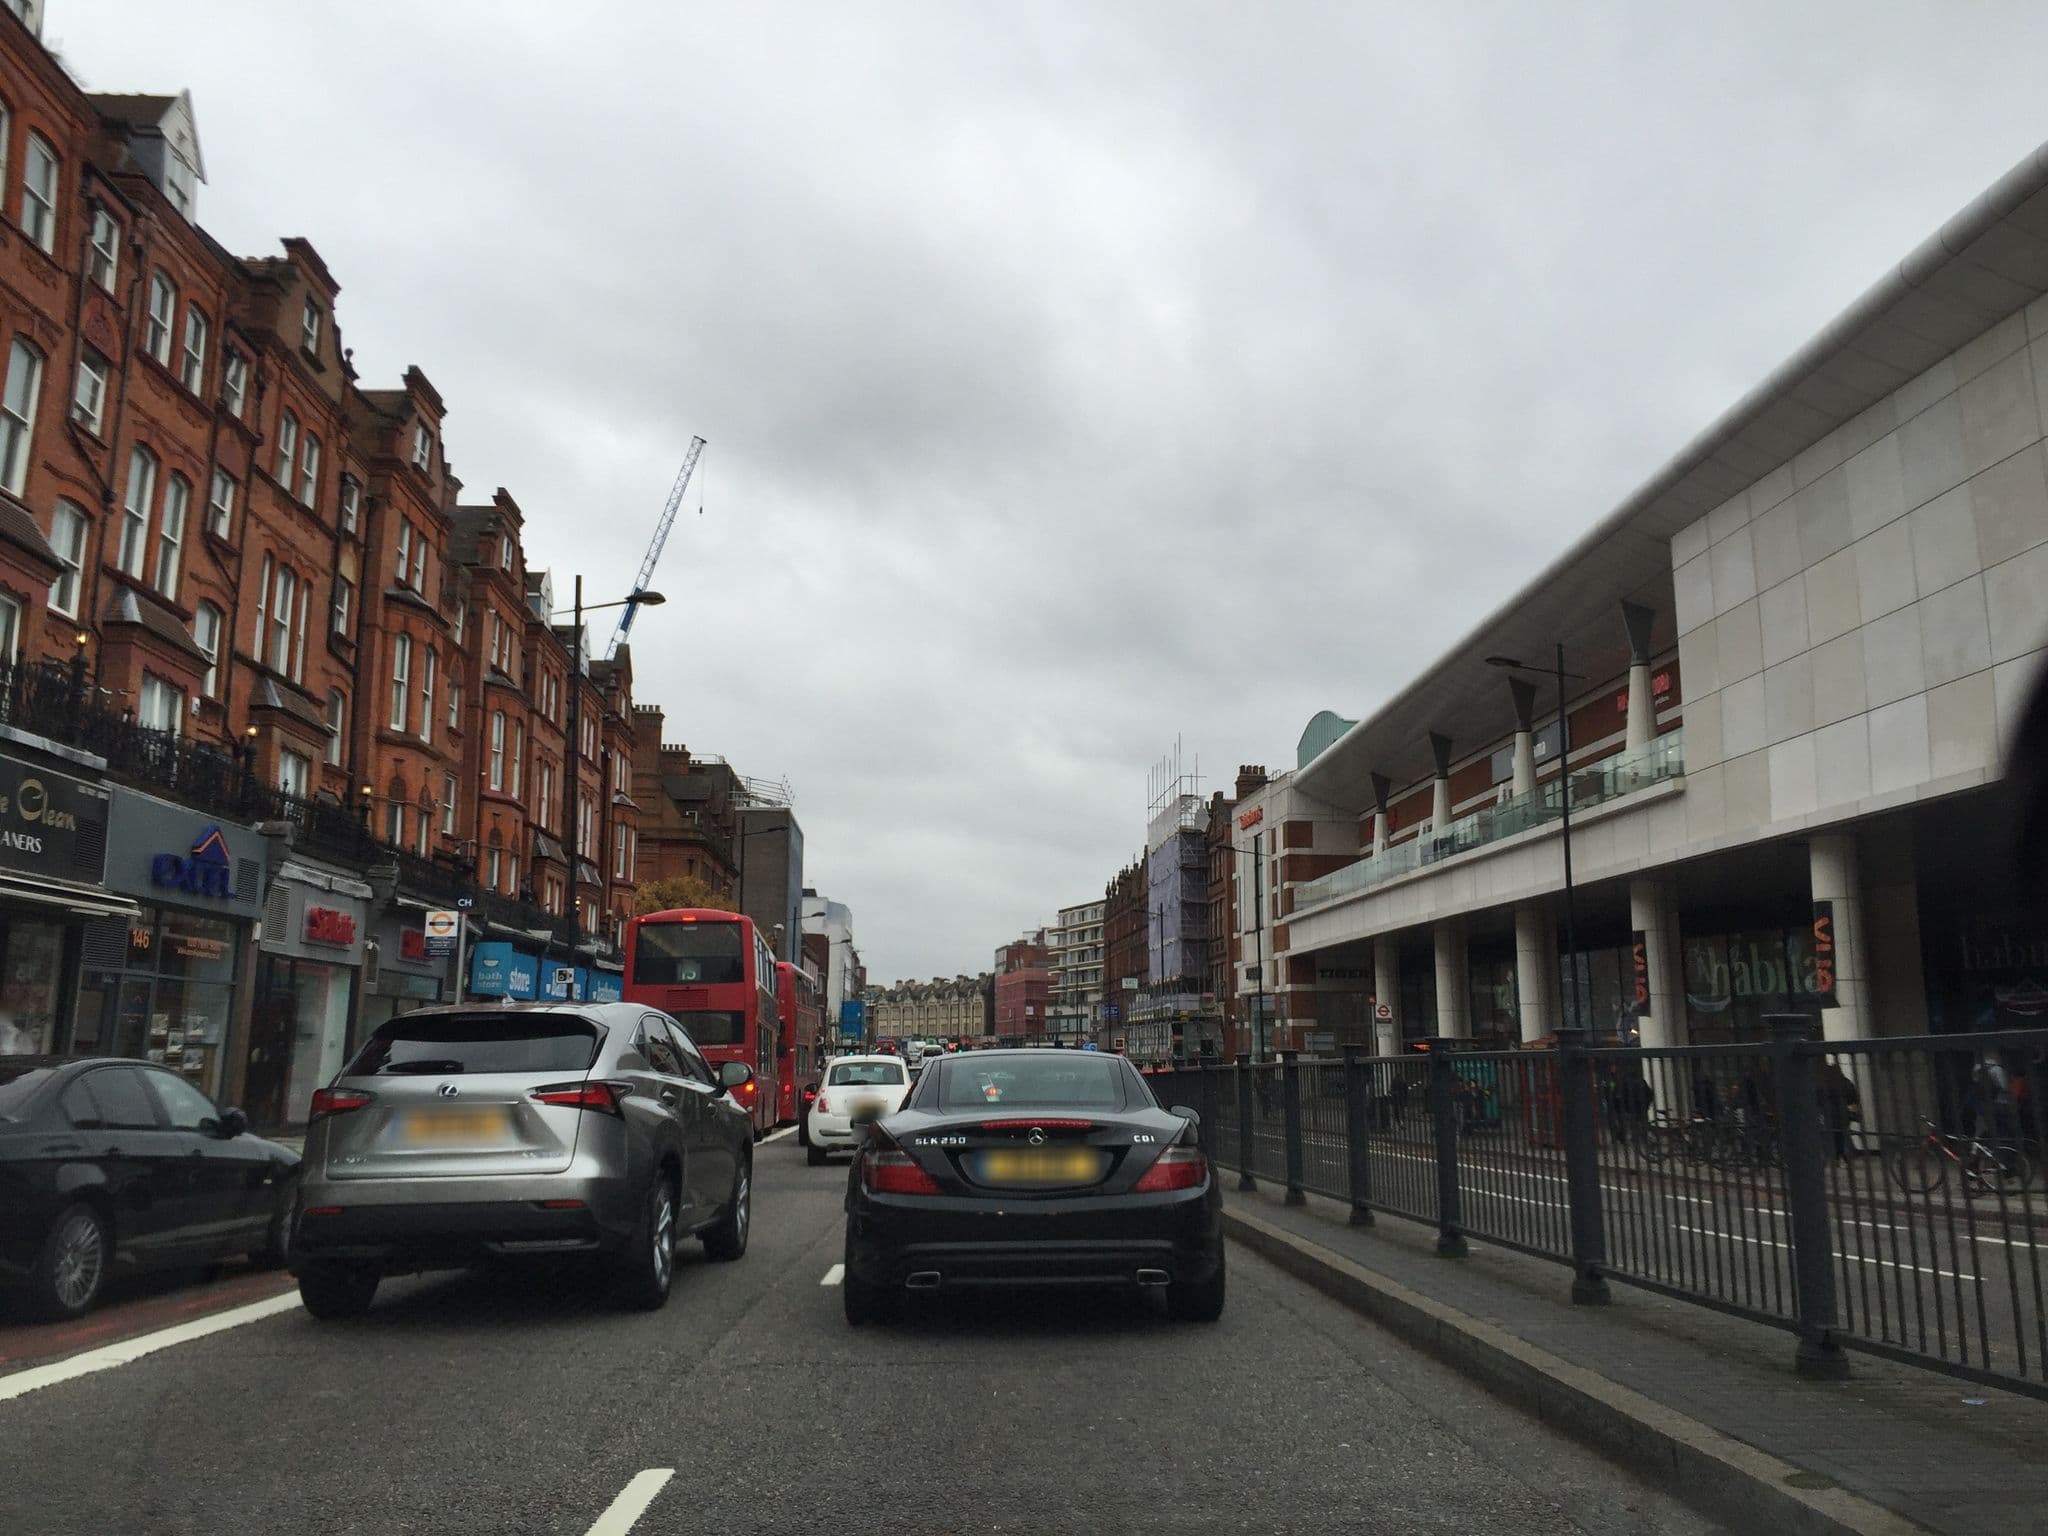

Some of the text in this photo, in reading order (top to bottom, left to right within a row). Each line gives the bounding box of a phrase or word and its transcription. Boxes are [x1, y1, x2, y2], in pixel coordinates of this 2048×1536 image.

[17, 778, 77, 832] Clean
[457, 898, 473, 907] CH
[132, 927, 151, 949] 146
[477, 970, 503, 981] bath
